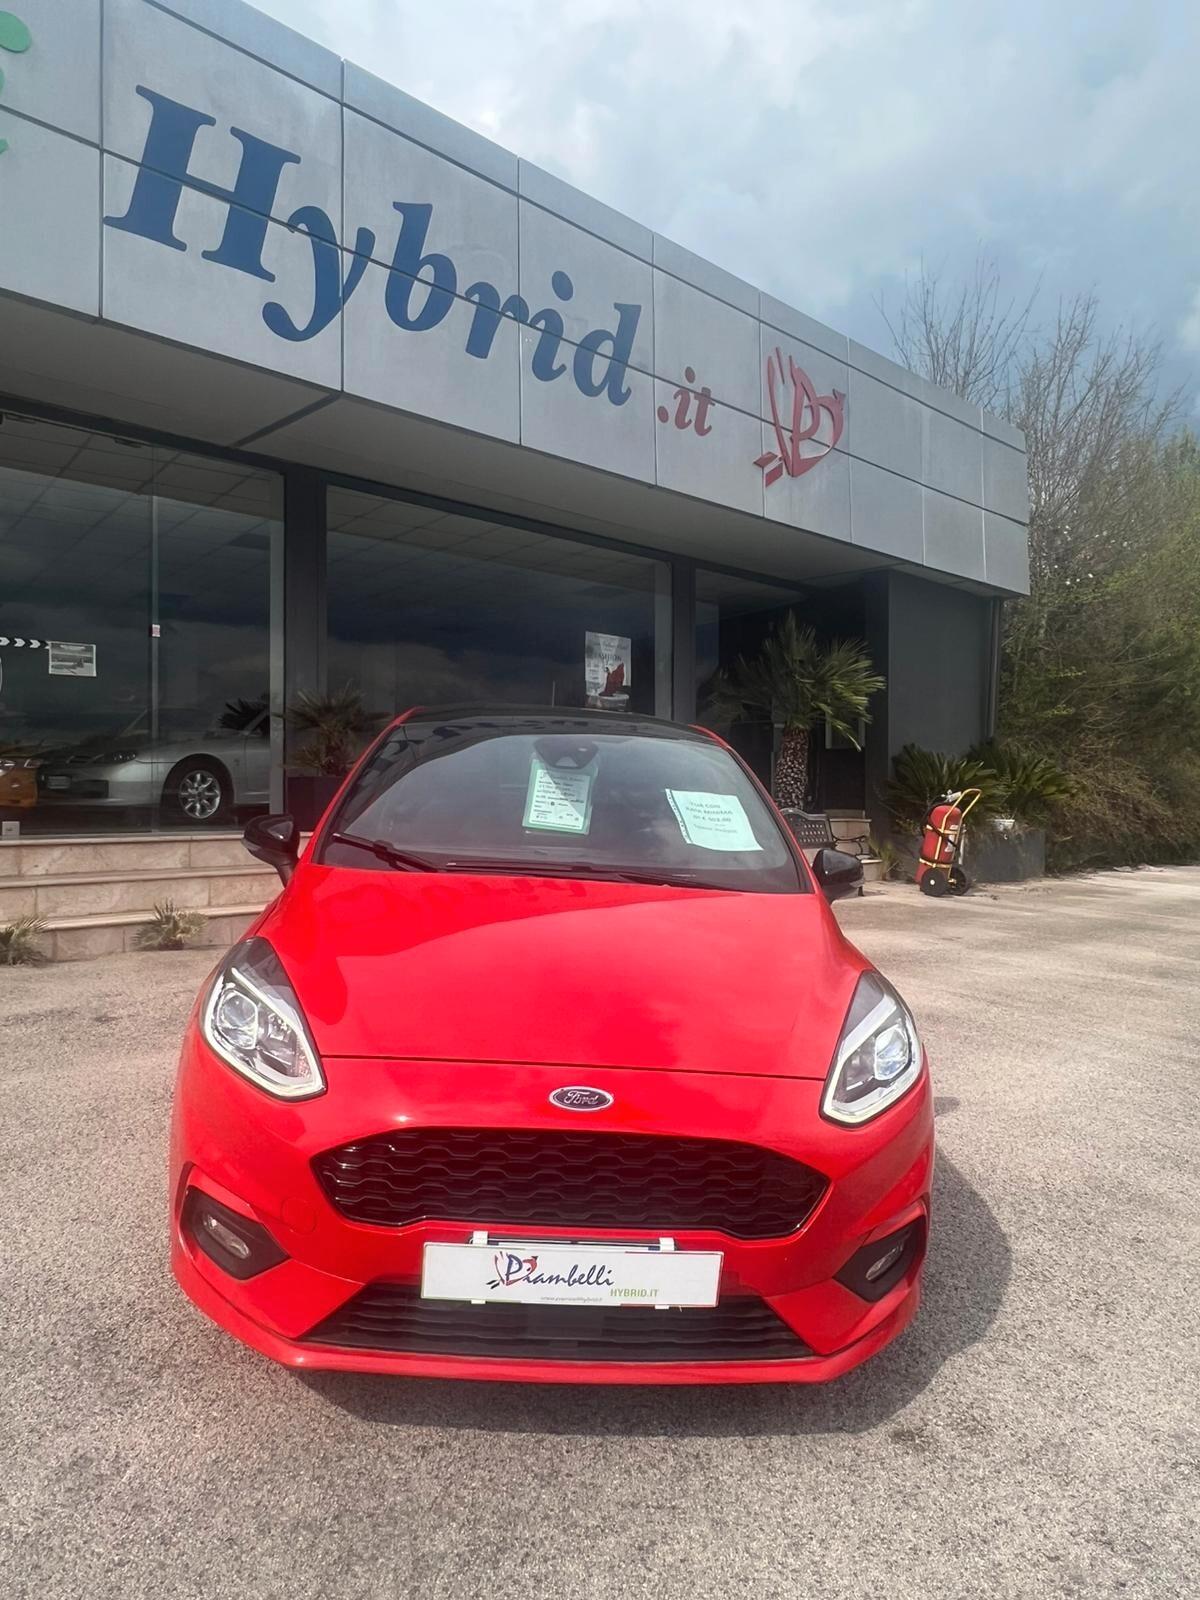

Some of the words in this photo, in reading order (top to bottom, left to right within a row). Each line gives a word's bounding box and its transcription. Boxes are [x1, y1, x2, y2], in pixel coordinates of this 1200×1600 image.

[103, 84, 642, 407] Hybrid
[563, 1090, 599, 1105] Ford
[503, 1252, 615, 1288] Piambelli
[610, 1287, 659, 1298] HYBRID.IT
